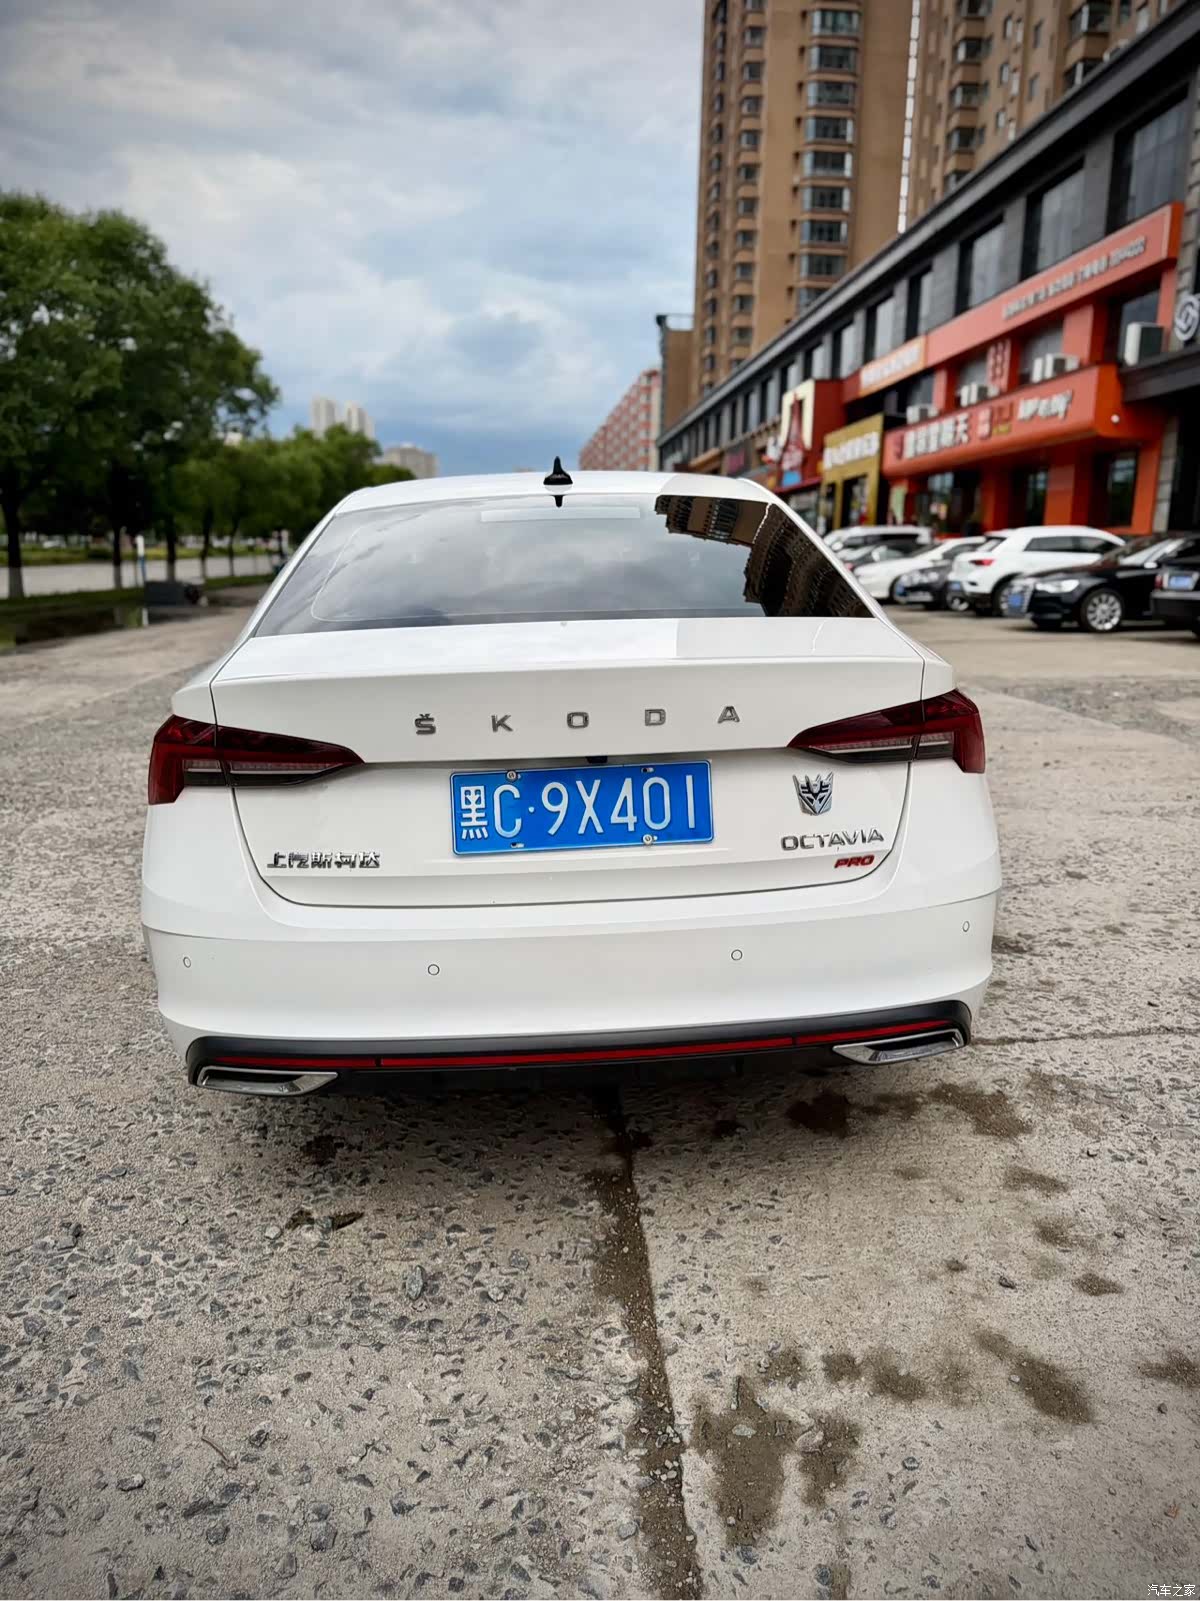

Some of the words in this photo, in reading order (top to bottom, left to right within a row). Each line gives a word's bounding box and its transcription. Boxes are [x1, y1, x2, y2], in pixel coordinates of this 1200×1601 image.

[414, 705, 741, 735] ŠKODA
[781, 827, 885, 851] OCTAVIA
[266, 851, 381, 869] 上汽斯柯达
[834, 854, 875, 869] PRO
